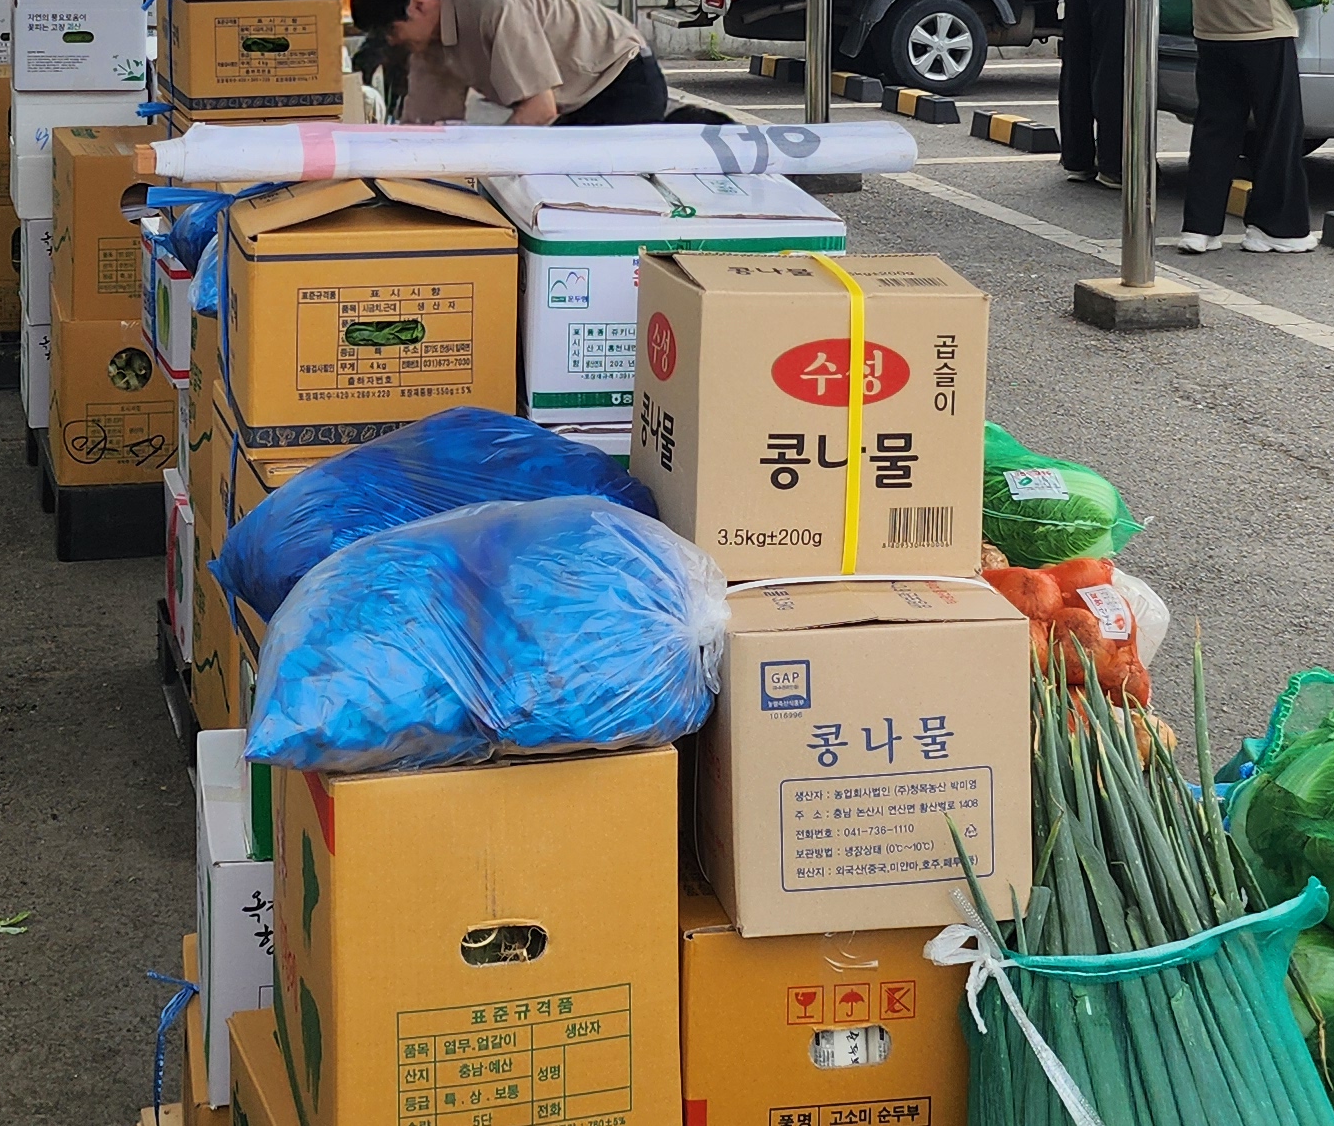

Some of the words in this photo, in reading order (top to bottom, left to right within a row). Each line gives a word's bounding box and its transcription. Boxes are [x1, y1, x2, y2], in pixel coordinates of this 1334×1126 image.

[28, 13, 49, 22] 자연의
[28, 23, 49, 32] 꽃피는
[51, 23, 66, 32] 고장
[650, 321, 671, 373] 수성
[933, 334, 959, 416] 곱슬이
[640, 391, 677, 474] 콩나물
[759, 432, 920, 491] 콩나물
[717, 528, 823, 548] 3.5kg±200g
[771, 671, 800, 684] GAP
[806, 715, 955, 768] 콩나물
[795, 789, 823, 802] 생산자
[834, 787, 890, 800] 농업회사법인
[950, 779, 977, 791] 박미영
[833, 808, 852, 819] 충남
[856, 806, 884, 817] 논산시
[888, 804, 915, 816] 연산면
[795, 830, 833, 840] 전화번호
[843, 824, 914, 837] 041-736-1110
[796, 848, 833, 859] 보관방법
[845, 844, 882, 857] 냉장상태
[796, 867, 825, 878] 원산지
[565, 1020, 601, 1038] 생산자
[404, 1042, 430, 1059] 품목
[404, 1067, 429, 1084] 산지
[537, 1065, 561, 1081] 성명
[404, 1095, 430, 1111] 등급
[470, 1089, 481, 1105] 상
[494, 1084, 520, 1100] 보통
[537, 1102, 561, 1119] 전화
[829, 1107, 872, 1125] 고소미
[877, 1104, 920, 1123] 순두부
